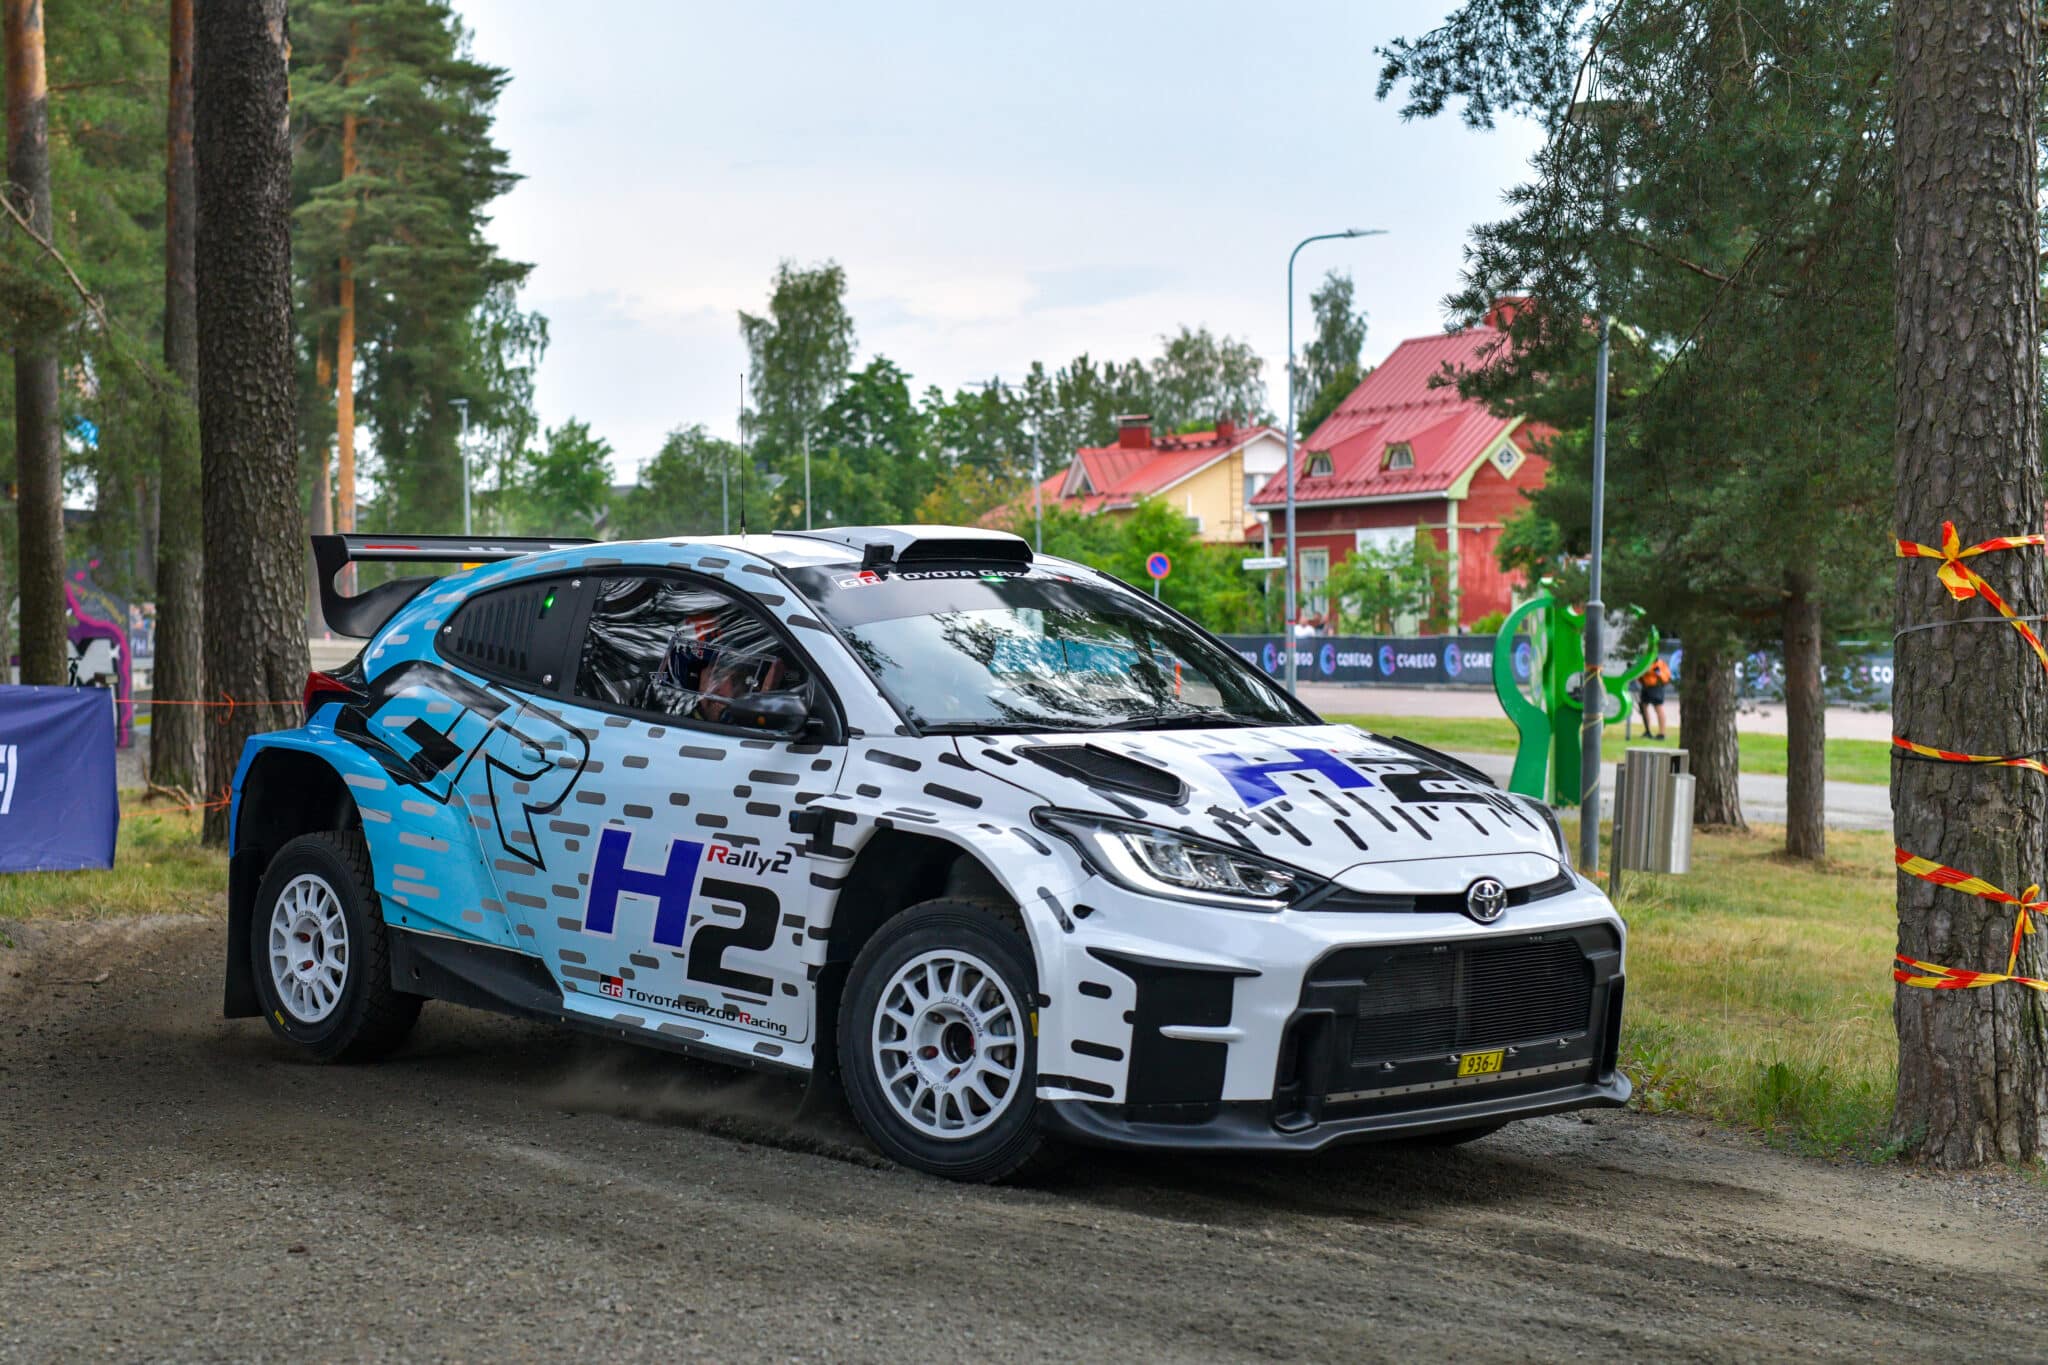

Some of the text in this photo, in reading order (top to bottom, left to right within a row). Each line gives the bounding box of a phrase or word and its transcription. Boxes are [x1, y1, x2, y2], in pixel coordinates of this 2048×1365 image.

[886, 570, 977, 581] TOYOTA
[706, 844, 793, 876] Rally2
[600, 981, 788, 1036] GR TOYOTA GAZOO Racing
[1467, 1053, 1500, 1073] 936-J
